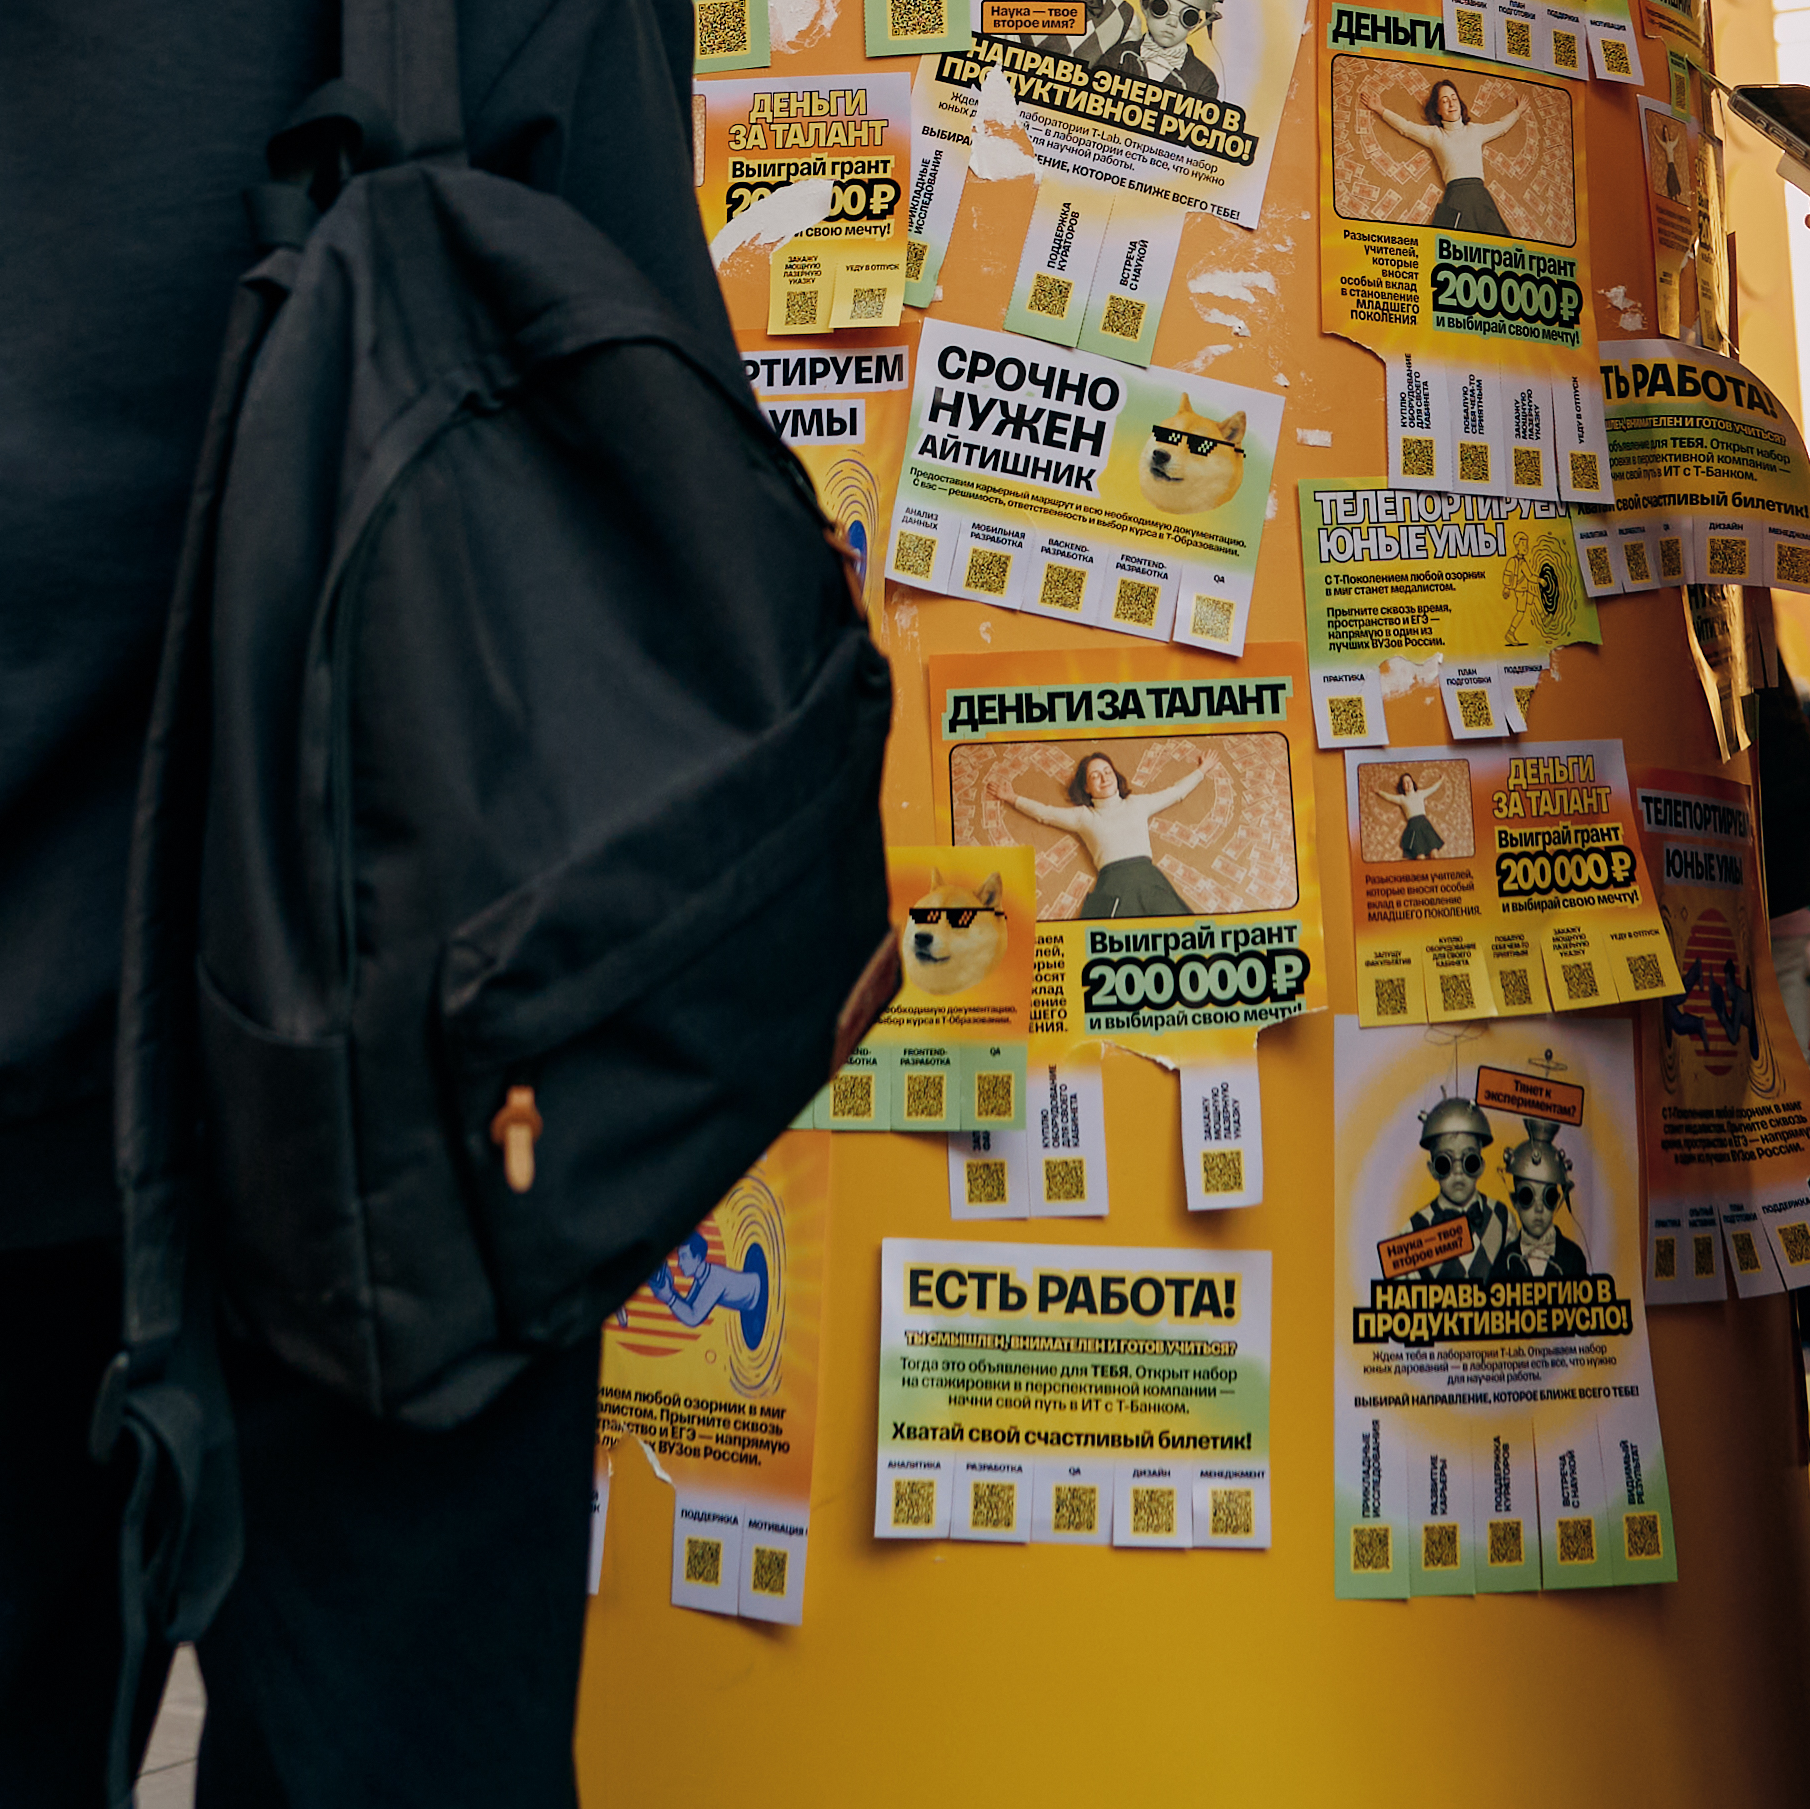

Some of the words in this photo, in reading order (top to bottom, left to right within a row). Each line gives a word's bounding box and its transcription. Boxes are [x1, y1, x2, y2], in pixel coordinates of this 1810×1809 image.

[991, 6, 1030, 18] Наука
[1048, 8, 1077, 17] твое
[993, 19, 1039, 30] второе
[1042, 18, 1075, 28] имя?
[1332, 9, 1446, 50] ДЕНЬГИ
[967, 39, 1089, 85] НАПРАВЬ
[1092, 71, 1219, 124] ЭНЕРГИЮ
[1224, 109, 1241, 131] В
[749, 89, 867, 123] ДЕНЬГИ
[729, 123, 769, 151] ЗА
[770, 120, 889, 150] ТАЛАНТ
[1160, 115, 1253, 161] РУСЛО!
[731, 158, 828, 179] Выиграй
[831, 159, 891, 178] грант
[805, 225, 843, 238] свою
[845, 223, 891, 239] мечту!
[1438, 239, 1525, 271] Выиграй
[1529, 254, 1576, 278] грант
[1436, 317, 1446, 328] и
[1448, 317, 1506, 338] выбирай
[1508, 324, 1539, 339] свою
[1542, 328, 1580, 347] мечту!
[937, 345, 1119, 412] СРОЧНО
[1635, 363, 1778, 420] РАБОТА!
[768, 408, 858, 438] УМЫ
[928, 386, 1107, 457] НУЖЕН
[918, 434, 1097, 492] АЙТИШНИК
[1732, 492, 1810, 519] билетик!
[1317, 526, 1429, 563] ЮНЫЕ
[1432, 523, 1507, 558] УМЫ
[949, 691, 1091, 734] ДЕНЬГИ
[1097, 692, 1145, 721] ЗА
[1147, 684, 1286, 718] ТАЛАНТ
[1506, 754, 1595, 791] ДЕНЬГИ
[1492, 790, 1526, 819] ЗА
[1527, 787, 1611, 817] ТАЛАНТ
[1497, 827, 1573, 850] Выиграй
[1575, 826, 1621, 847] грант
[1664, 846, 1715, 881] ЮНЫЕ
[1717, 852, 1744, 885] УМЫ
[1502, 902, 1510, 913] и
[1512, 895, 1560, 913] выбирай
[1562, 894, 1594, 909] свою
[1597, 889, 1639, 909] мечту!
[1090, 930, 1215, 957] Выиграй
[1221, 925, 1297, 952] грант
[1090, 1018, 1101, 1030] и
[1106, 1013, 1187, 1033] выбирай
[1191, 1010, 1239, 1026] свою
[908, 1268, 1027, 1312] ЕСТЬ
[1038, 1274, 1236, 1319] РАБОТА!
[1376, 1284, 1486, 1310] НАПРАВЬ
[1490, 1280, 1593, 1307] ЭНЕРГИЮ
[1596, 1279, 1612, 1303] В
[1358, 1309, 1548, 1341] ПРОДУКТИВНОЕ
[1551, 1305, 1628, 1333] РУСЛО!
[901, 1357, 939, 1373] Тогда
[942, 1360, 966, 1371] это
[969, 1358, 1057, 1376] объявление
[1060, 1364, 1088, 1378] для
[1091, 1364, 1133, 1379] ТЕБЯ.
[1135, 1366, 1189, 1381] Открыт
[1192, 1367, 1237, 1382] набор
[892, 1421, 964, 1442] Хватай
[968, 1424, 1021, 1444] свой
[1024, 1427, 1154, 1449] счастливый
[1158, 1431, 1252, 1451] билетик!
